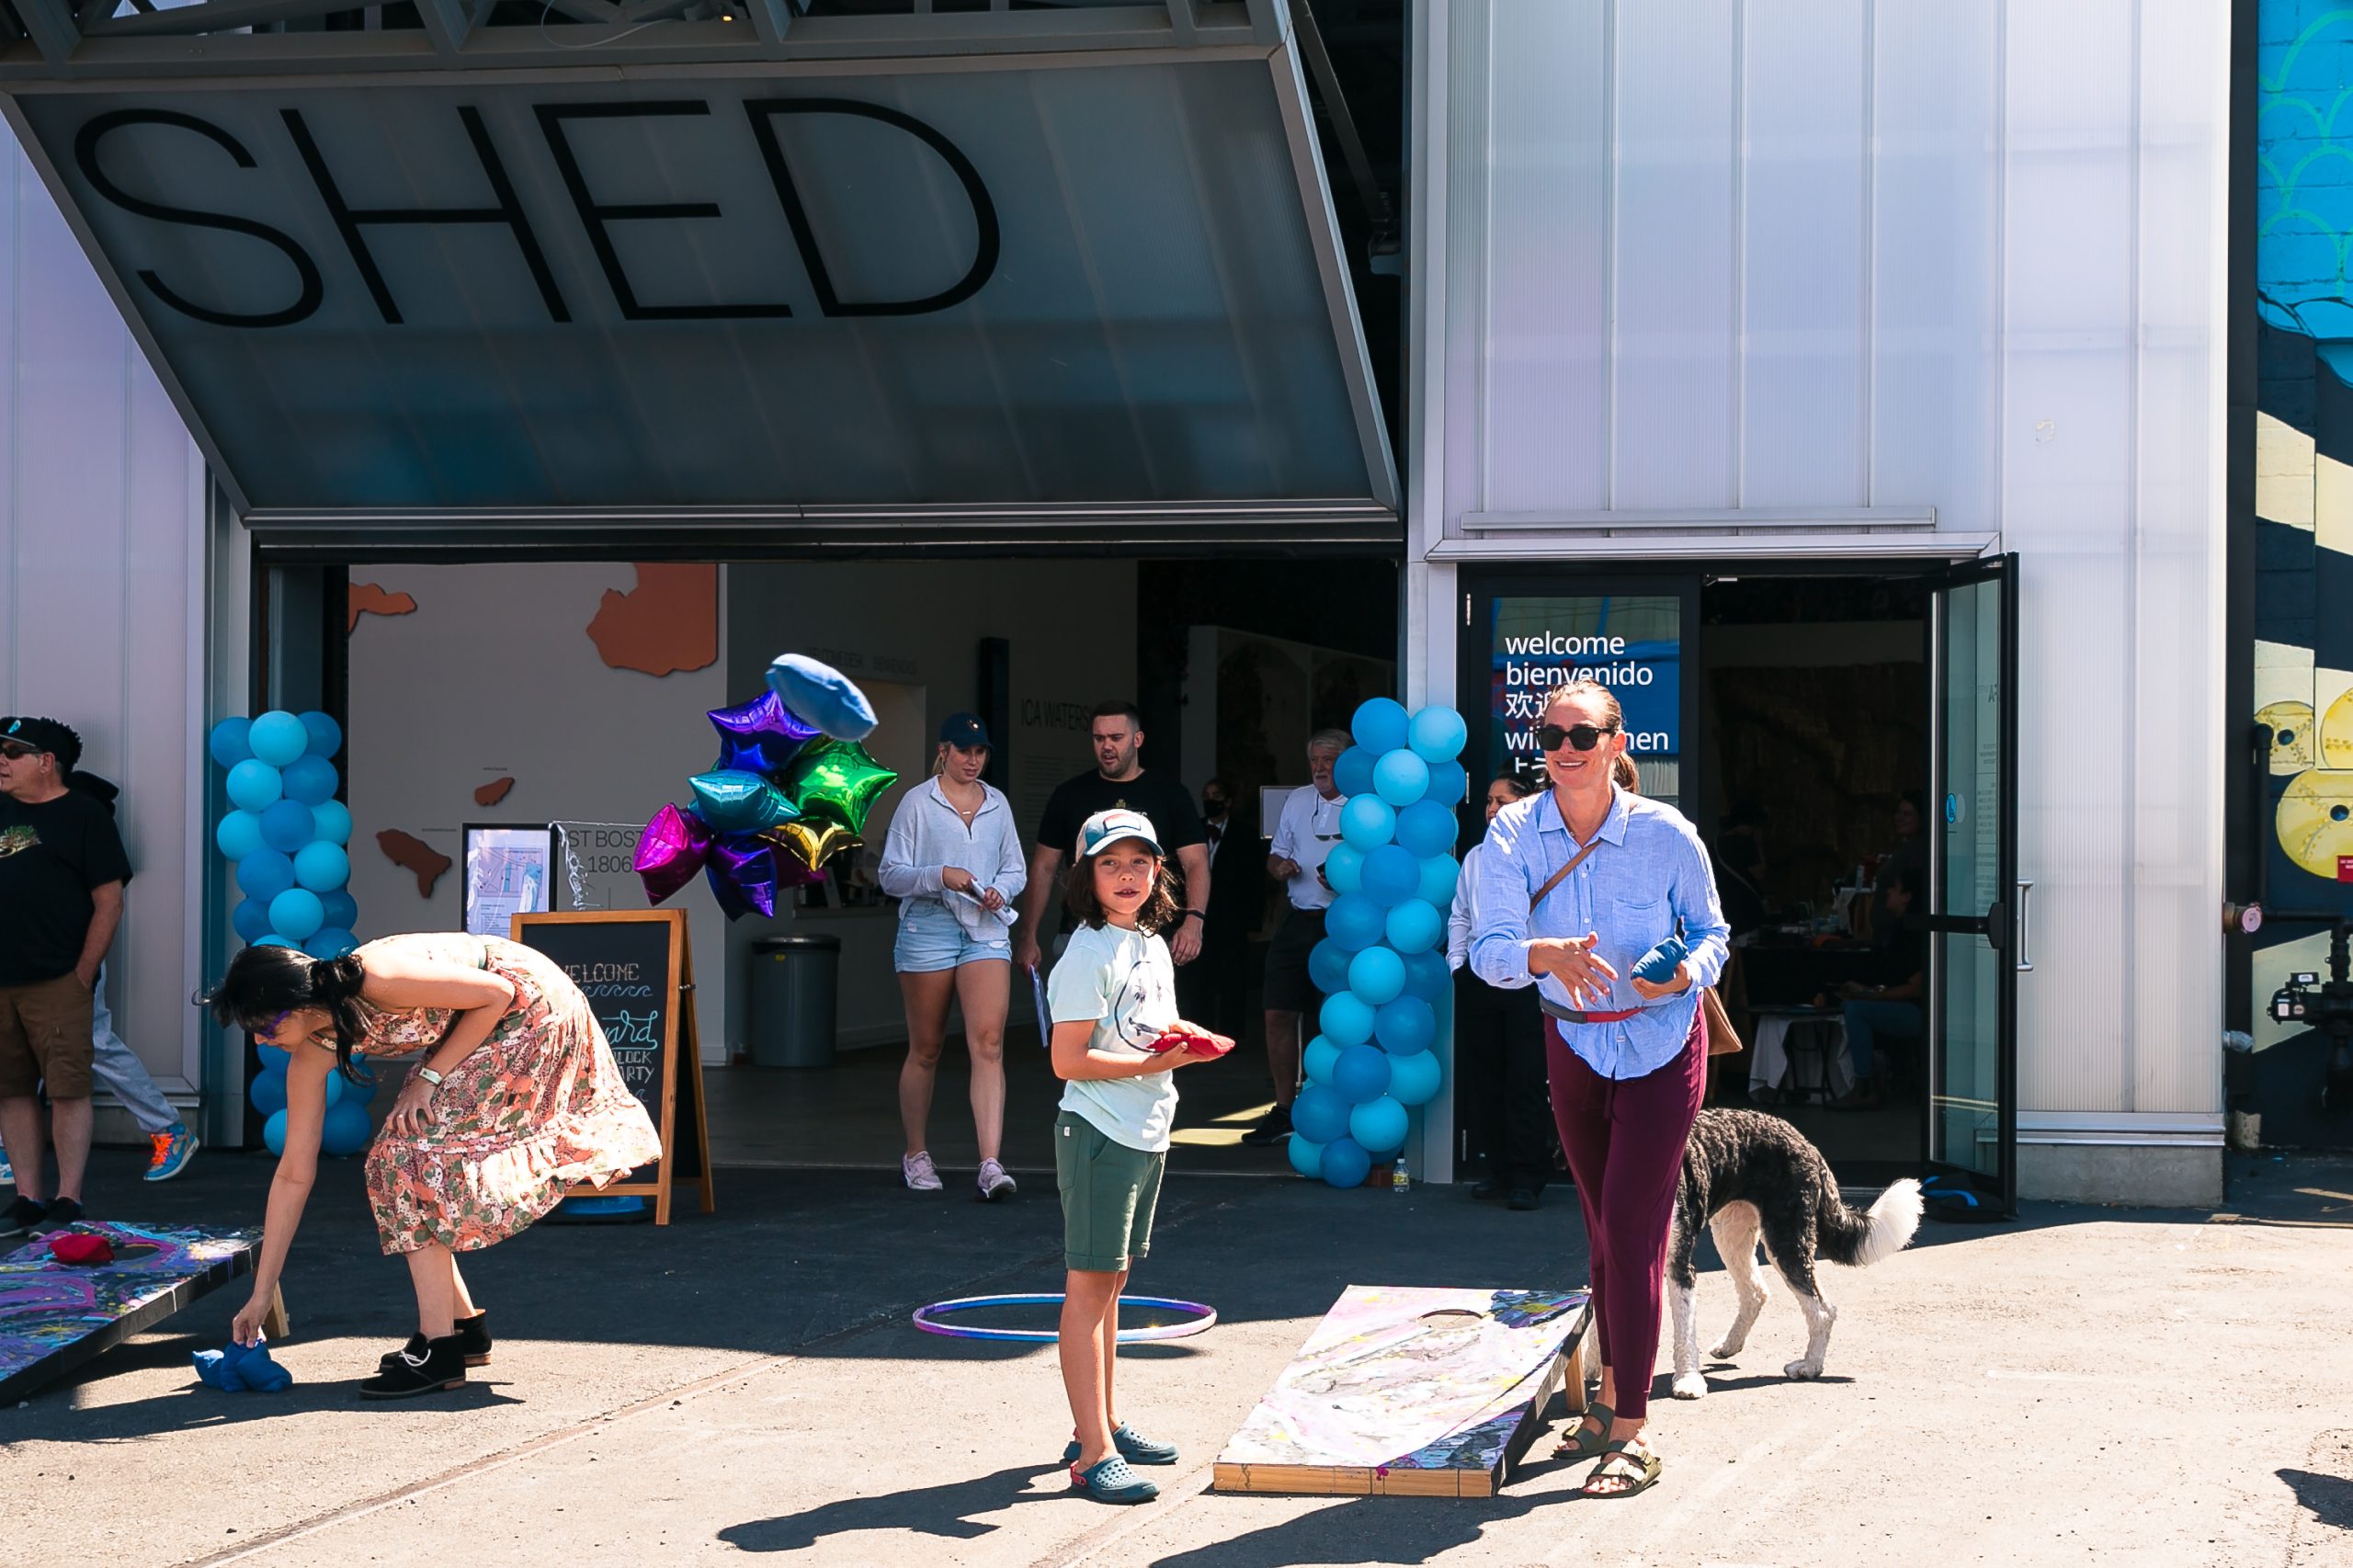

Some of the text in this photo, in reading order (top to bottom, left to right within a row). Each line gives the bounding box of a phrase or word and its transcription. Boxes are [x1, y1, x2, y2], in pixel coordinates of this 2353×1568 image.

[74, 97, 1000, 328] SHED
[1505, 631, 1625, 655] welcome
[1506, 661, 1654, 686] bienvenido
[1021, 699, 1091, 732] ICA WATERS
[567, 830, 643, 847] ST BOS
[587, 855, 632, 873] 1806
[604, 1009, 658, 1050] ard
